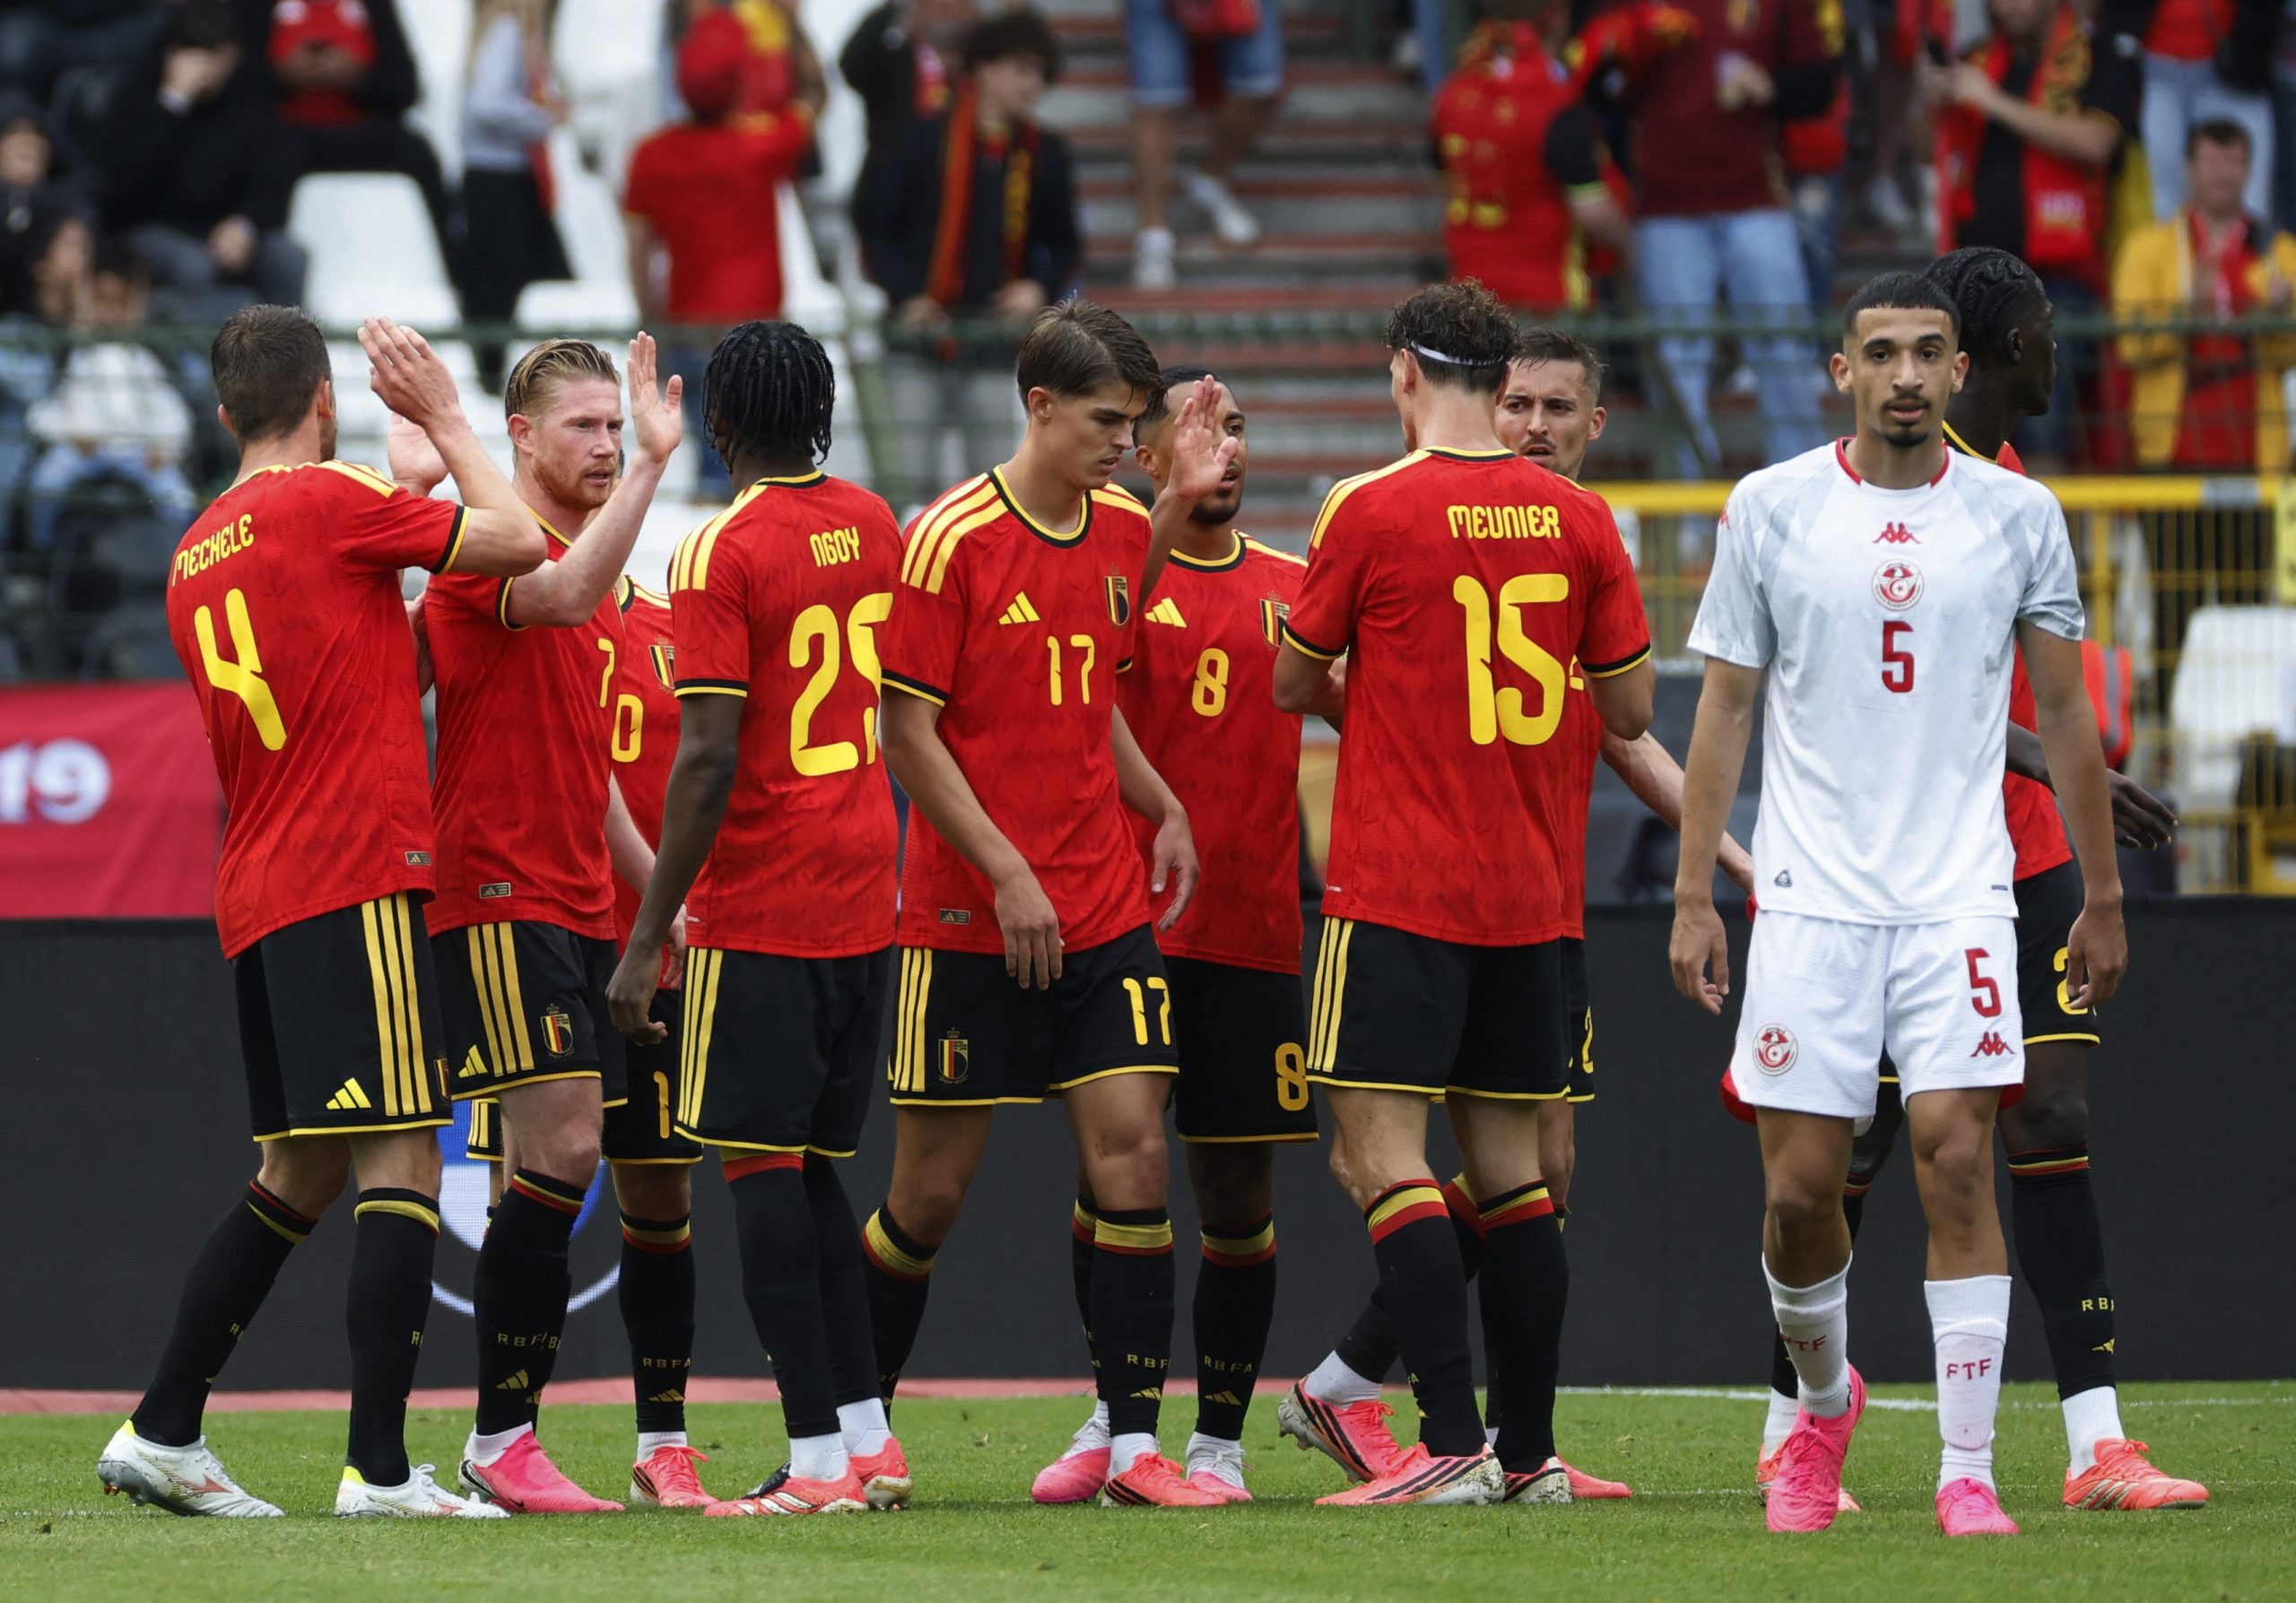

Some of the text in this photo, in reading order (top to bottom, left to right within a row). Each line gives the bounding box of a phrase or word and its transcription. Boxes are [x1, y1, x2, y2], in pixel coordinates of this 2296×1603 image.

[172, 513, 255, 587] MECHELE
[810, 527, 860, 567] NGOY
[1447, 505, 1561, 538] MEUNIER
[194, 588, 286, 750] 4
[597, 638, 615, 709] 7
[1047, 634, 1095, 706] 17
[1192, 648, 1230, 717] 8
[1452, 572, 1570, 745] 15
[1882, 621, 1914, 693] 5
[1122, 977, 1171, 1046] 17
[1964, 947, 2002, 1018] 5
[1275, 1042, 1309, 1111] 8
[2082, 1297, 2115, 1312] RB
[642, 1357, 691, 1369] RBFA
[1126, 1354, 1171, 1370] RBF
[1205, 1355, 1252, 1373] RBFA
[1946, 1357, 1992, 1381] FTF
